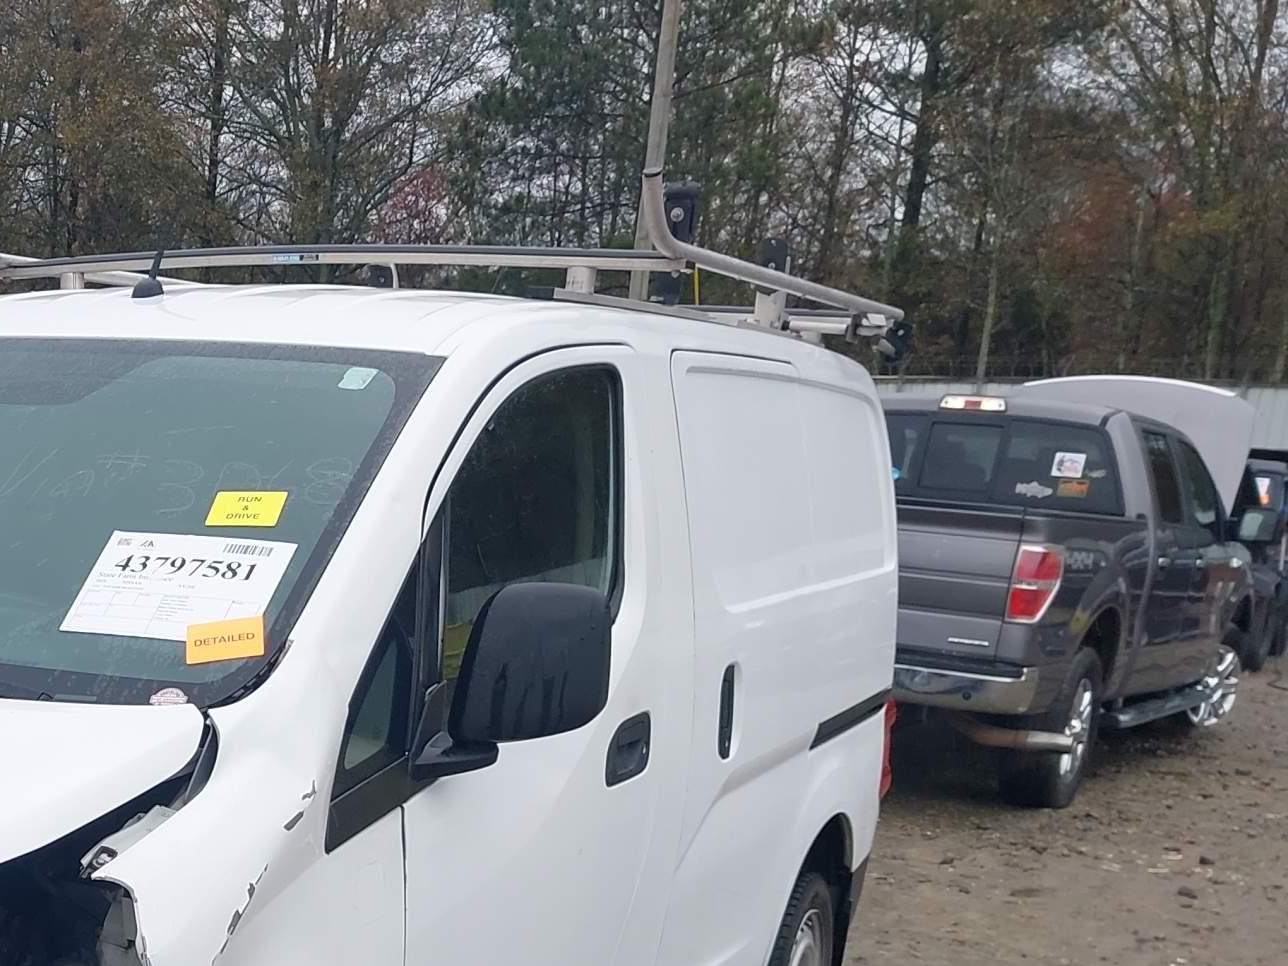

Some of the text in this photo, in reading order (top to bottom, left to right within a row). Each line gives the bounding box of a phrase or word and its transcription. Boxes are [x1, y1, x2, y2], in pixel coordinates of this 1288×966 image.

[225, 512, 261, 520] DRIVE
[114, 554, 257, 581] 43797581
[194, 632, 255, 648] DETAILED
